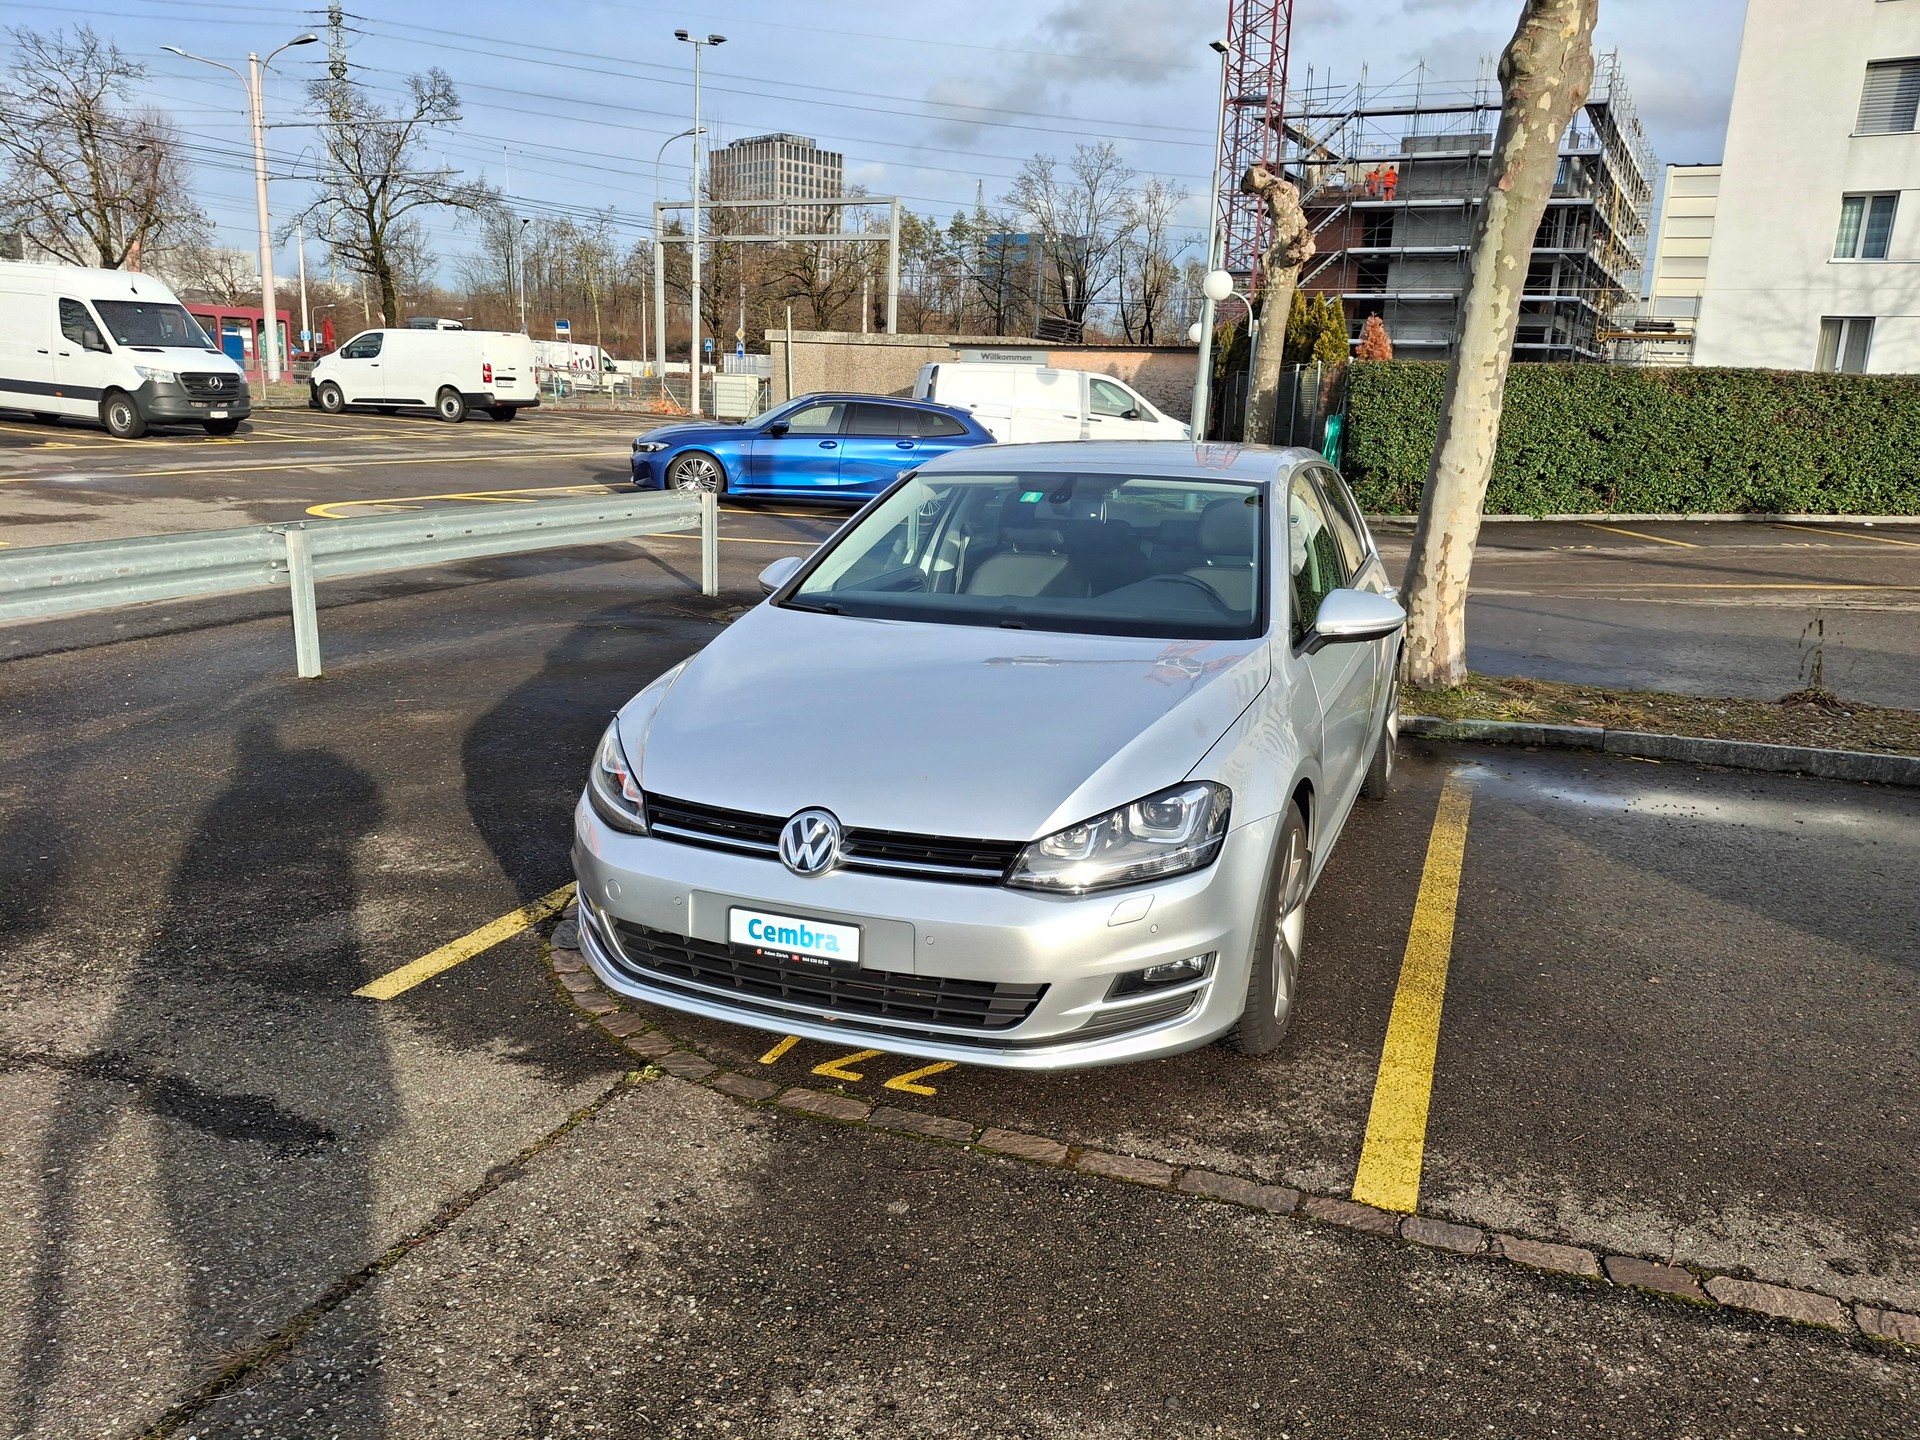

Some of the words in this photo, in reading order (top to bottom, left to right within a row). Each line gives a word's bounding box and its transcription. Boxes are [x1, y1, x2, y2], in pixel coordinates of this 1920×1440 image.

[980, 352, 1033, 361] Willkommen
[783, 813, 837, 873] VW
[748, 918, 840, 952] Cembra
